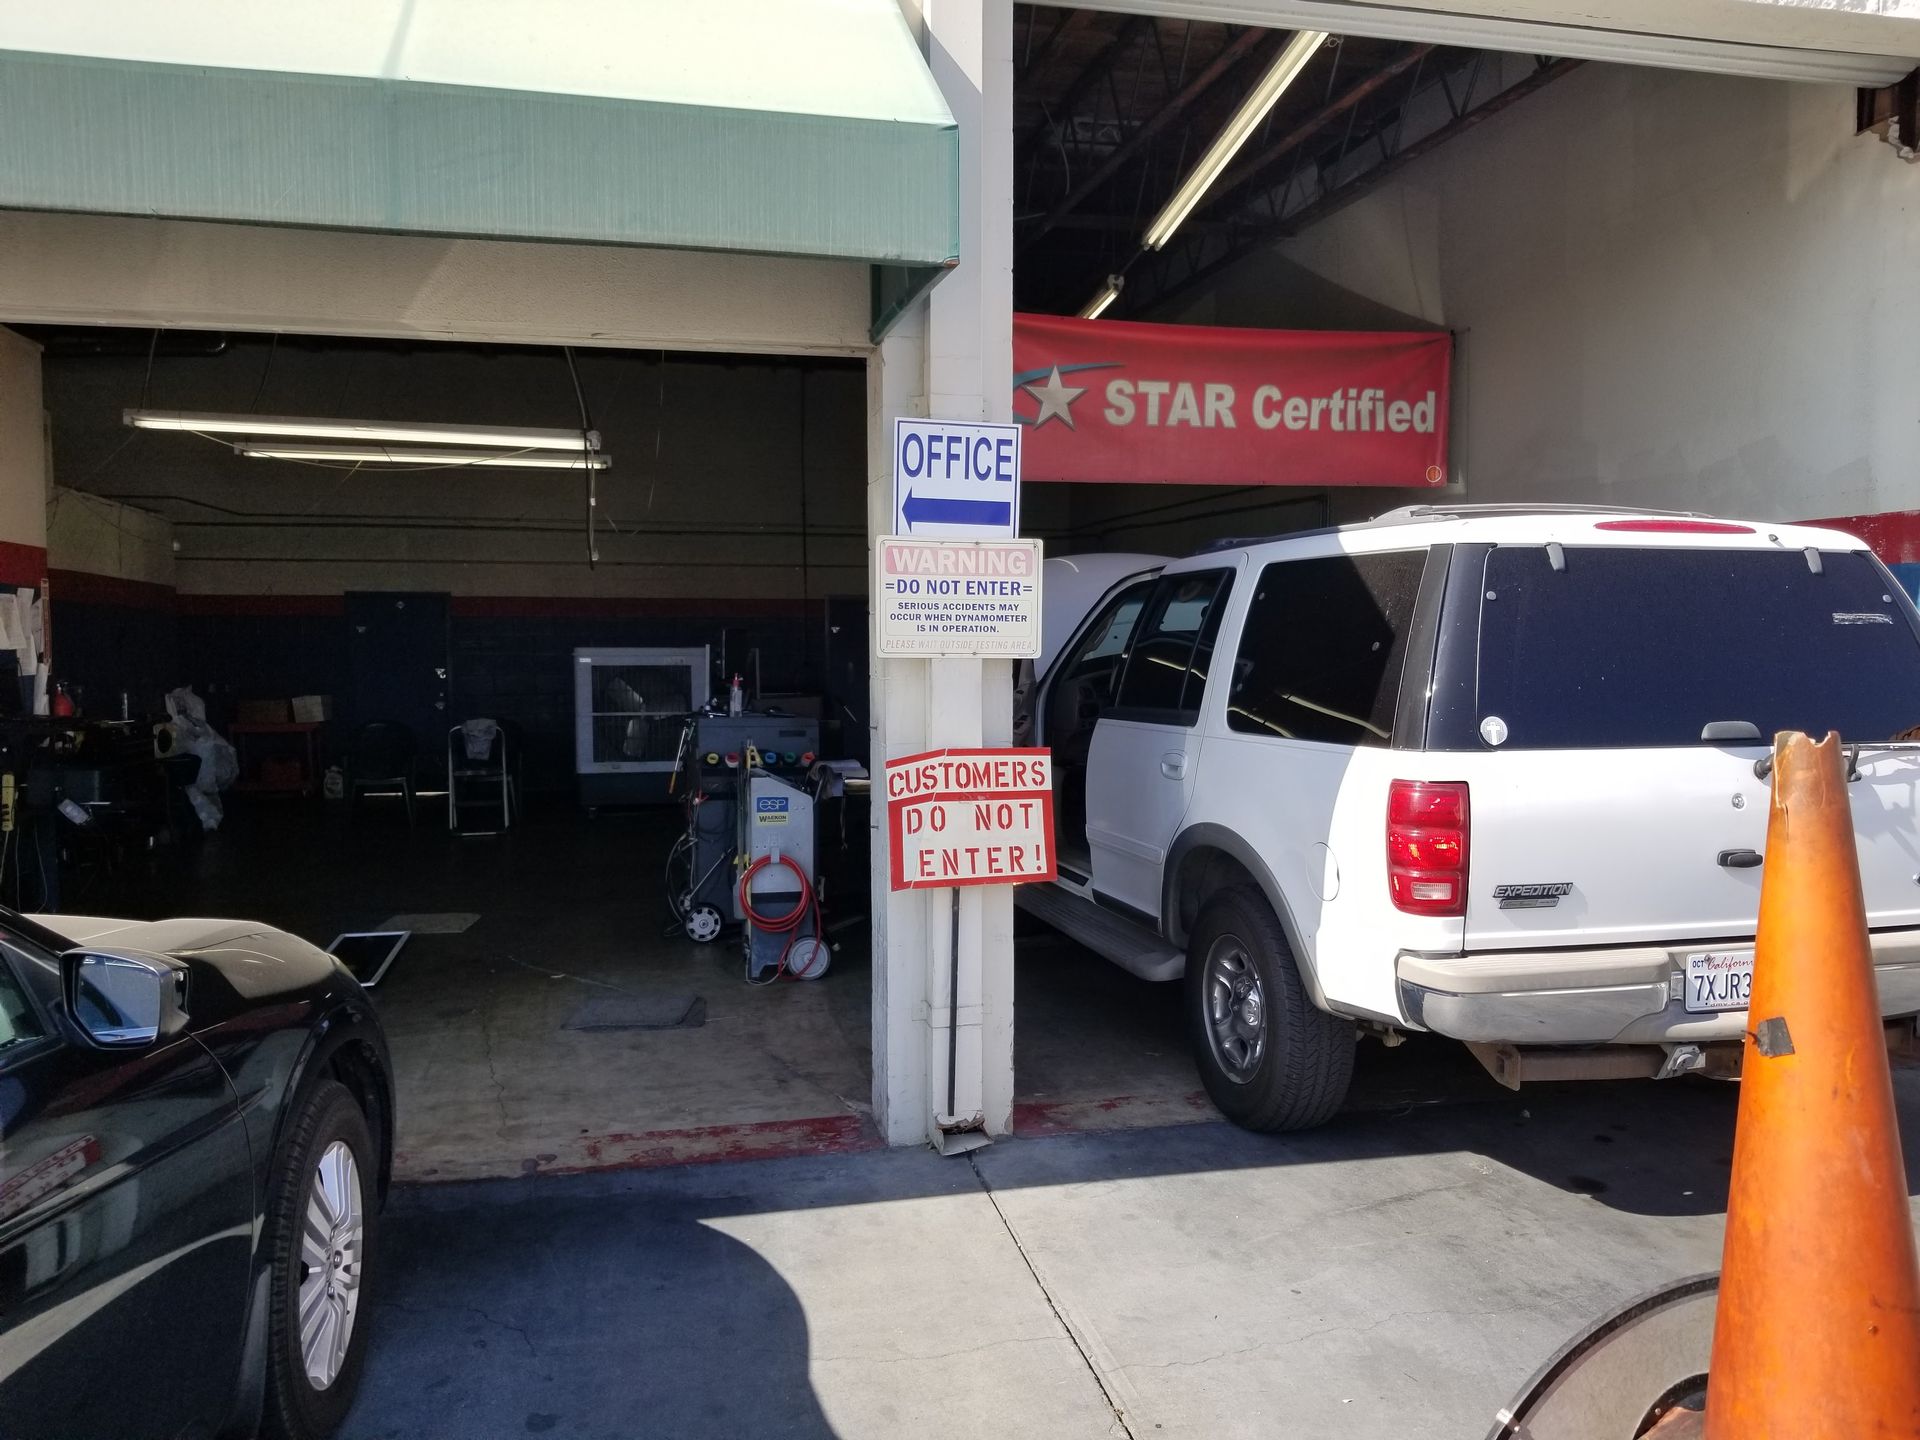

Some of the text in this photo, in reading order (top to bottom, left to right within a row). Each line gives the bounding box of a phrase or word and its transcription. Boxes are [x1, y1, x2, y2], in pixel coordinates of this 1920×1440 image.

[1103, 379, 1436, 433] STAR Certified
[902, 432, 1013, 482] OFFICE
[892, 548, 1027, 575] WARNING
[896, 579, 1021, 596] DO NOT ENTER
[898, 602, 1019, 612] SERIOUS ACCIDENTS MAY
[889, 613, 1028, 623] OCCUR WHEN DYNAMOMETER
[916, 624, 999, 634] IS IN OPERATION.
[886, 639, 1032, 651] PLEASE WAIT OUTSIDE TESTING AREA
[889, 760, 1046, 798] CUSTOMERS
[906, 803, 1033, 835] DO NOT
[919, 845, 1042, 877] ENTER!
[1494, 884, 1572, 897] EXPEDITION
[1692, 960, 1704, 968] OCT
